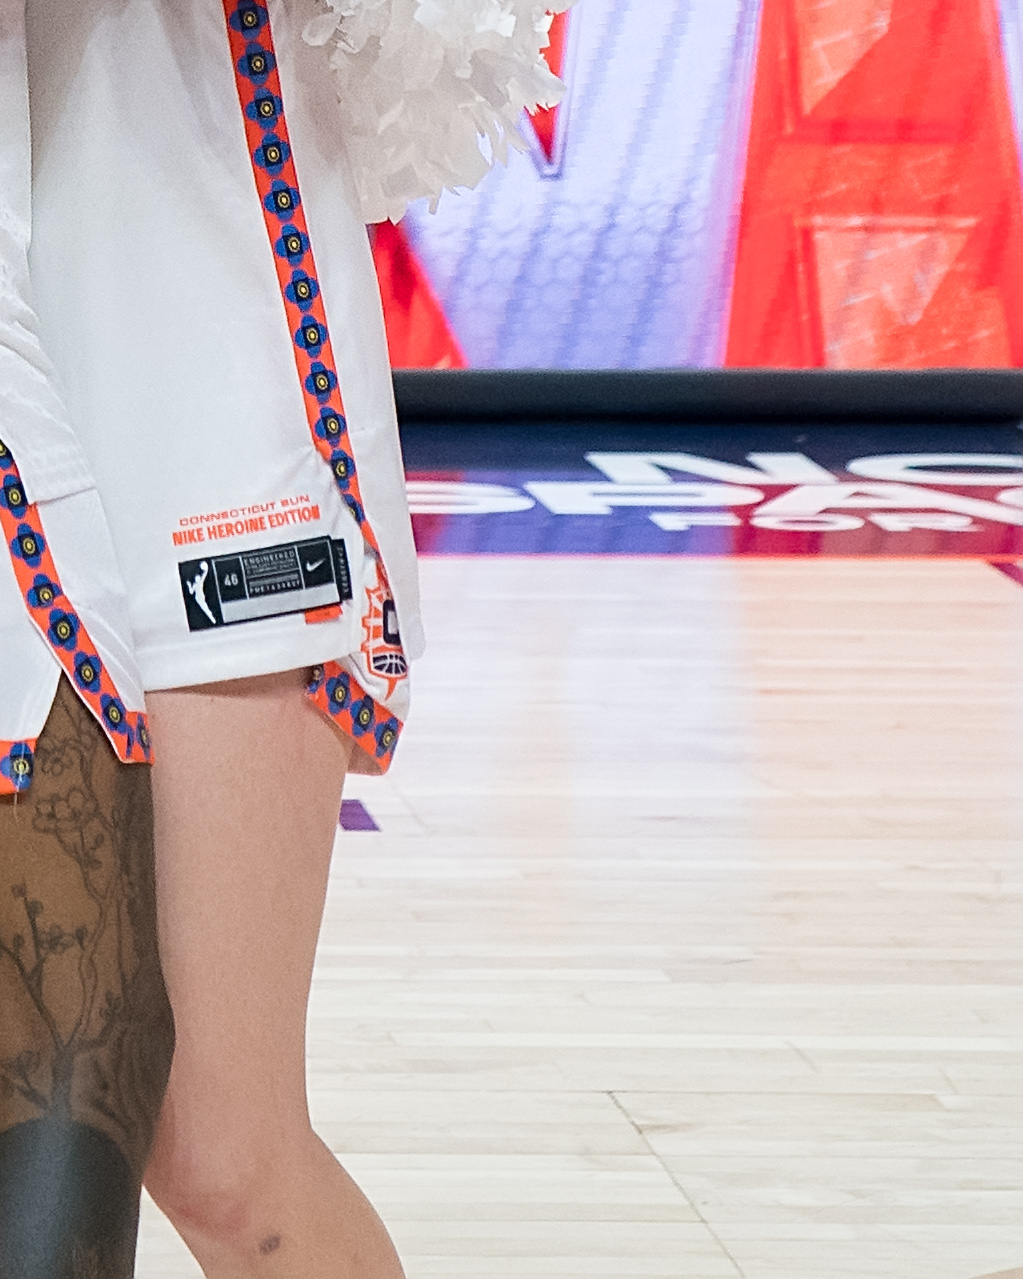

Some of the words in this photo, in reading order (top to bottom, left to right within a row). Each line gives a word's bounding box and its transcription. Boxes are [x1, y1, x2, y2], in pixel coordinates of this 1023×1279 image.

[172, 527, 205, 546] NIKE
[207, 515, 267, 540] HEROINE
[270, 504, 321, 527] EDITION
